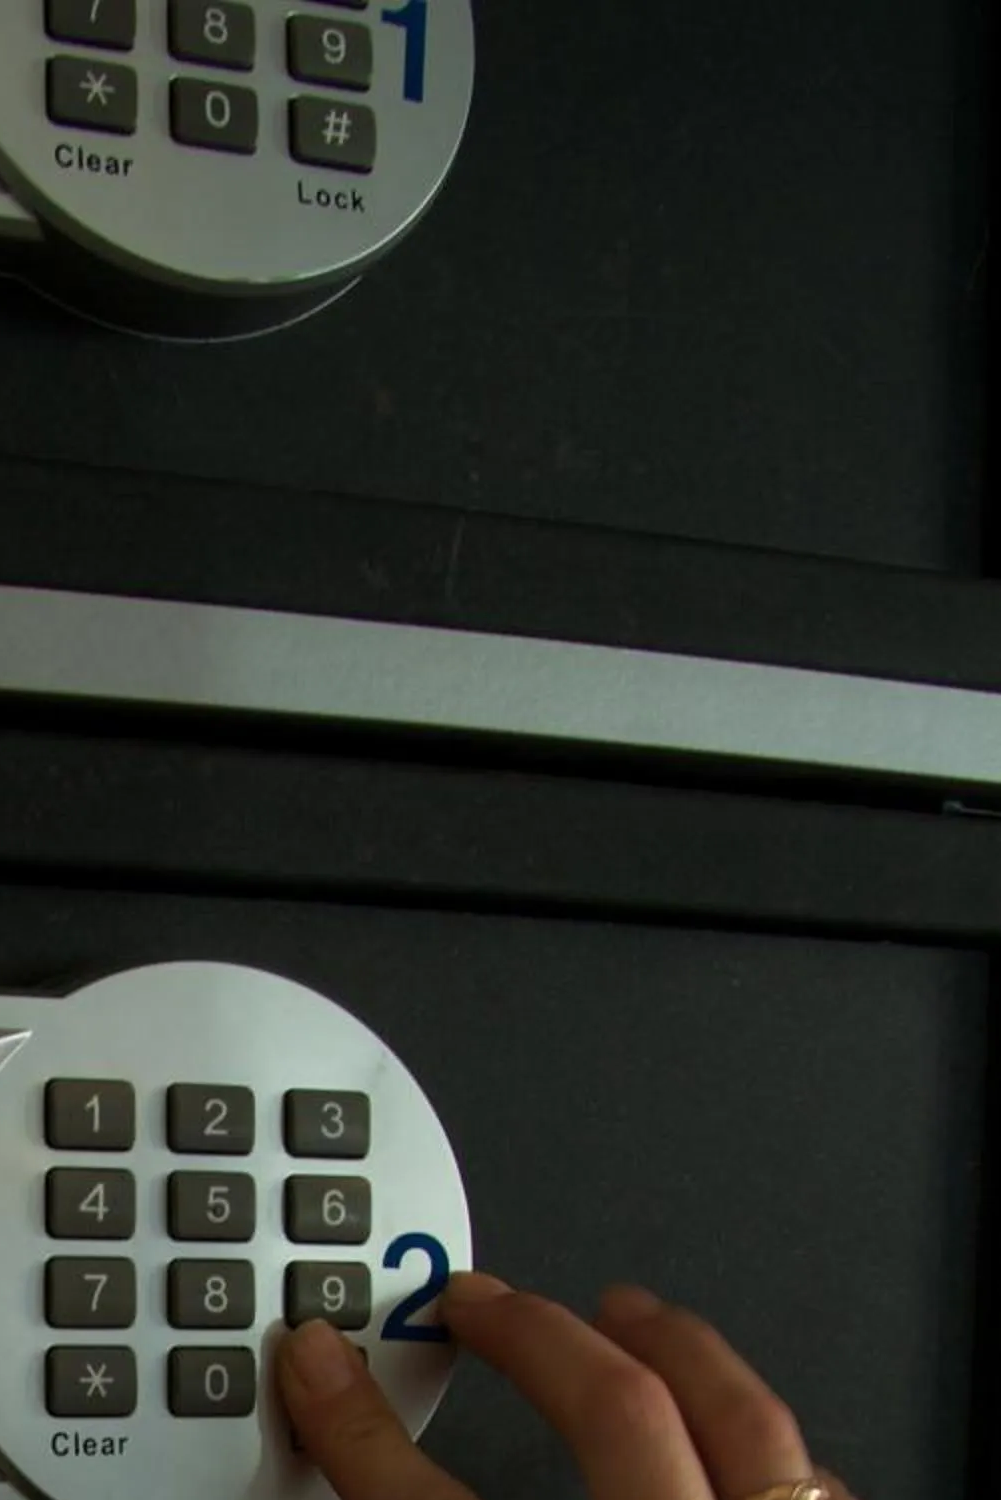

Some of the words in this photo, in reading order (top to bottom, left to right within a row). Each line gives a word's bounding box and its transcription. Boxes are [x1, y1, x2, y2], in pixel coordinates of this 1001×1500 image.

[203, 8, 228, 44] 8
[321, 28, 346, 64] 9
[381, 0, 427, 102] 1
[205, 90, 230, 129] 0
[322, 110, 351, 146] #
[54, 143, 133, 177] Clear
[298, 180, 365, 213] Lock
[84, 1095, 100, 1133] 1
[204, 1098, 229, 1136] 2
[320, 1102, 345, 1138] 3
[79, 1183, 110, 1222] 4
[206, 1186, 231, 1223] 5
[322, 1189, 346, 1226] 6
[83, 1274, 108, 1312] 7
[203, 1276, 228, 1313] 8
[322, 1276, 346, 1312] 9
[380, 1232, 451, 1343] 2
[204, 1363, 229, 1400] 0
[51, 1432, 129, 1456] Clear
